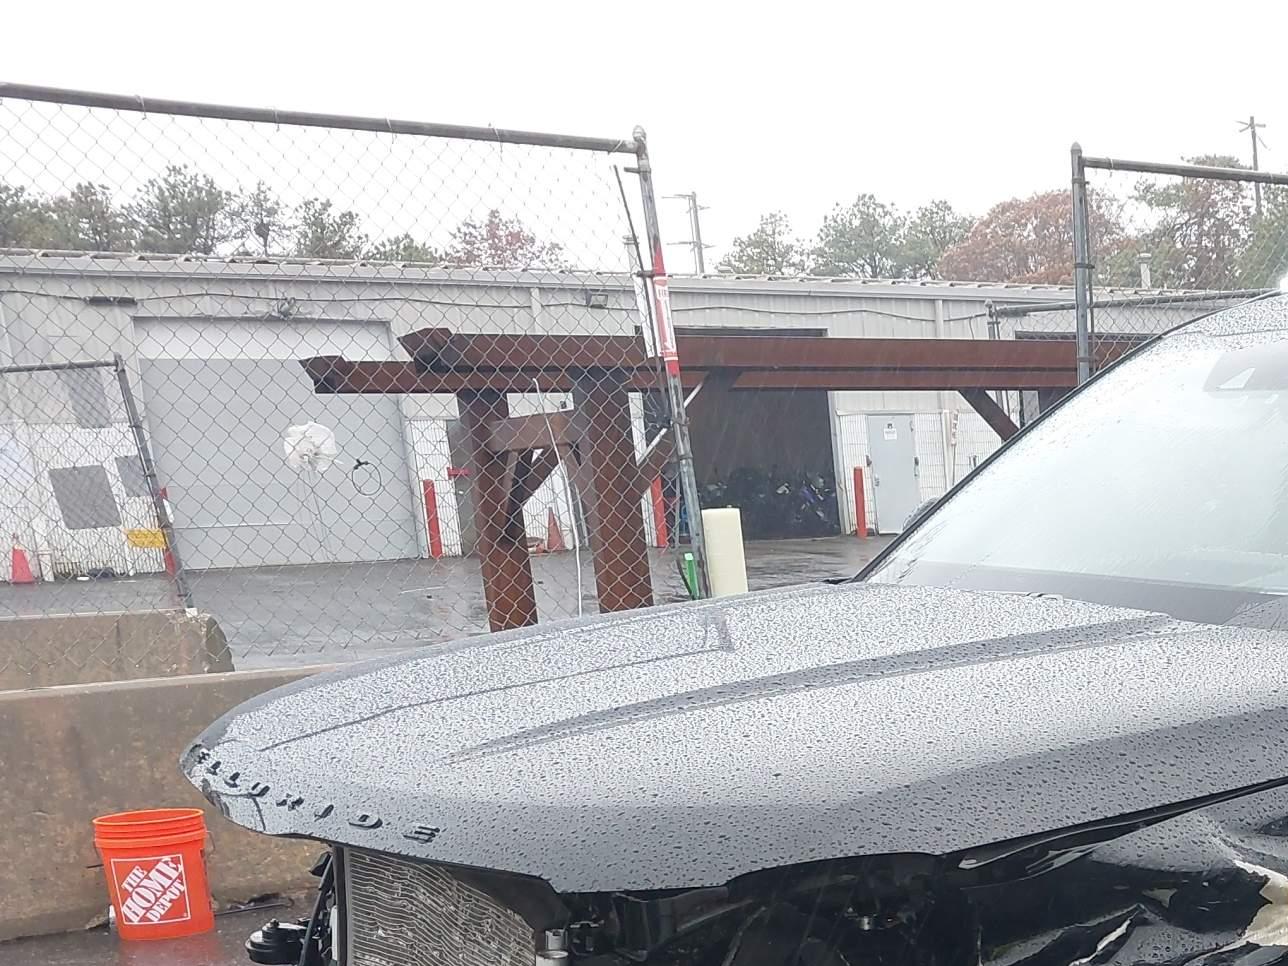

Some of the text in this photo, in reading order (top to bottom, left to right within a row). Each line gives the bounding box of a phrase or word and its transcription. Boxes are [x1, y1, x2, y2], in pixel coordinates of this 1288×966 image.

[121, 865, 147, 894] THE
[122, 857, 182, 923] HOME
[145, 879, 187, 923] DEPOT
